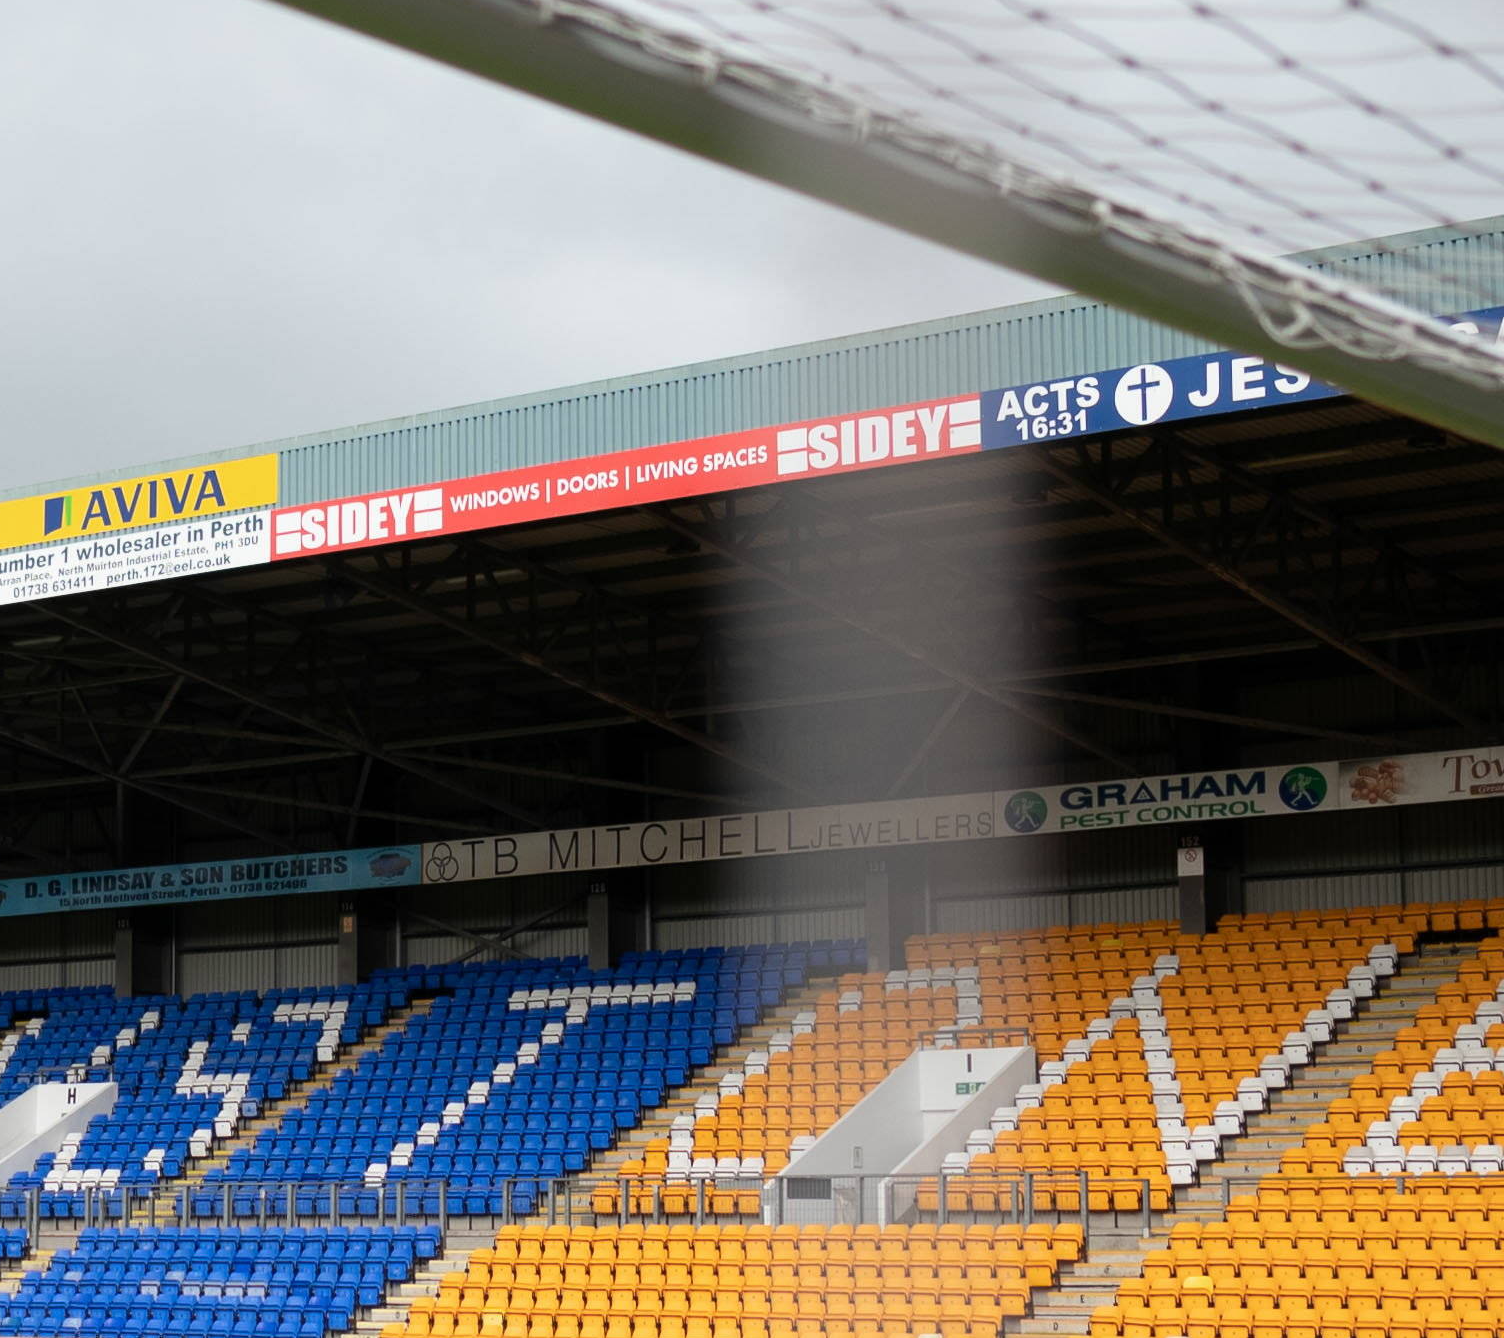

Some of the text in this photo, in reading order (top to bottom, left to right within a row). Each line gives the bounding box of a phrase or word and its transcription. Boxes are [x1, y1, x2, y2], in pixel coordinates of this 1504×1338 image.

[997, 376, 1099, 422] ACTS
[1016, 410, 1088, 440] 16:31
[302, 405, 947, 550] SIDEY WINDOWS DOORS LIVING SPACES SIDEY
[82, 469, 226, 531] AVIVA
[61, 547, 68, 562] 1
[76, 534, 180, 561] wholesaler
[187, 525, 203, 542] in
[211, 516, 264, 538] Perth
[87, 560, 123, 572] Muirton
[126, 550, 171, 567] Industrial
[215, 540, 234, 551] PH1
[238, 536, 258, 548] 3DU
[14, 577, 94, 598] 01738 631411
[1061, 771, 1266, 811] GRAHAM
[1061, 800, 1266, 830] PEST CONTROL
[550, 811, 812, 871] MITCHELL
[72, 855, 347, 895] LINDSAY SON BUTCHERS
